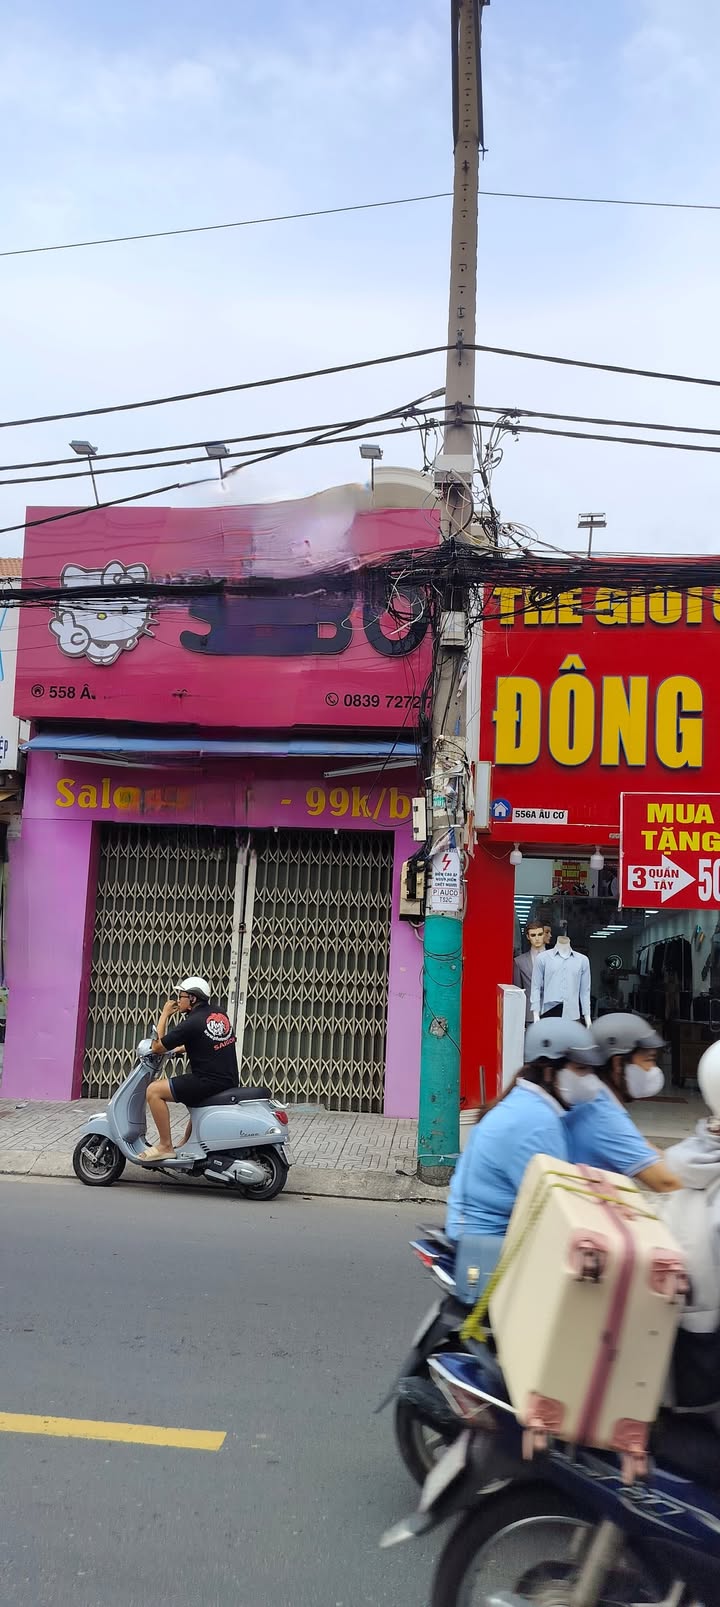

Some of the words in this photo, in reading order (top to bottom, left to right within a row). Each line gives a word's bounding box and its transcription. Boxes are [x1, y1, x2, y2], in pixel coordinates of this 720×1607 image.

[49, 685, 76, 699] 558
[343, 693, 380, 708] 0839
[492, 653, 704, 769] ĐÔNG
[305, 786, 411, 820] 99k/b
[647, 803, 715, 824] MUA
[515, 810, 537, 819] 556A
[640, 826, 720, 856] TẶNG
[632, 867, 647, 889] 3
